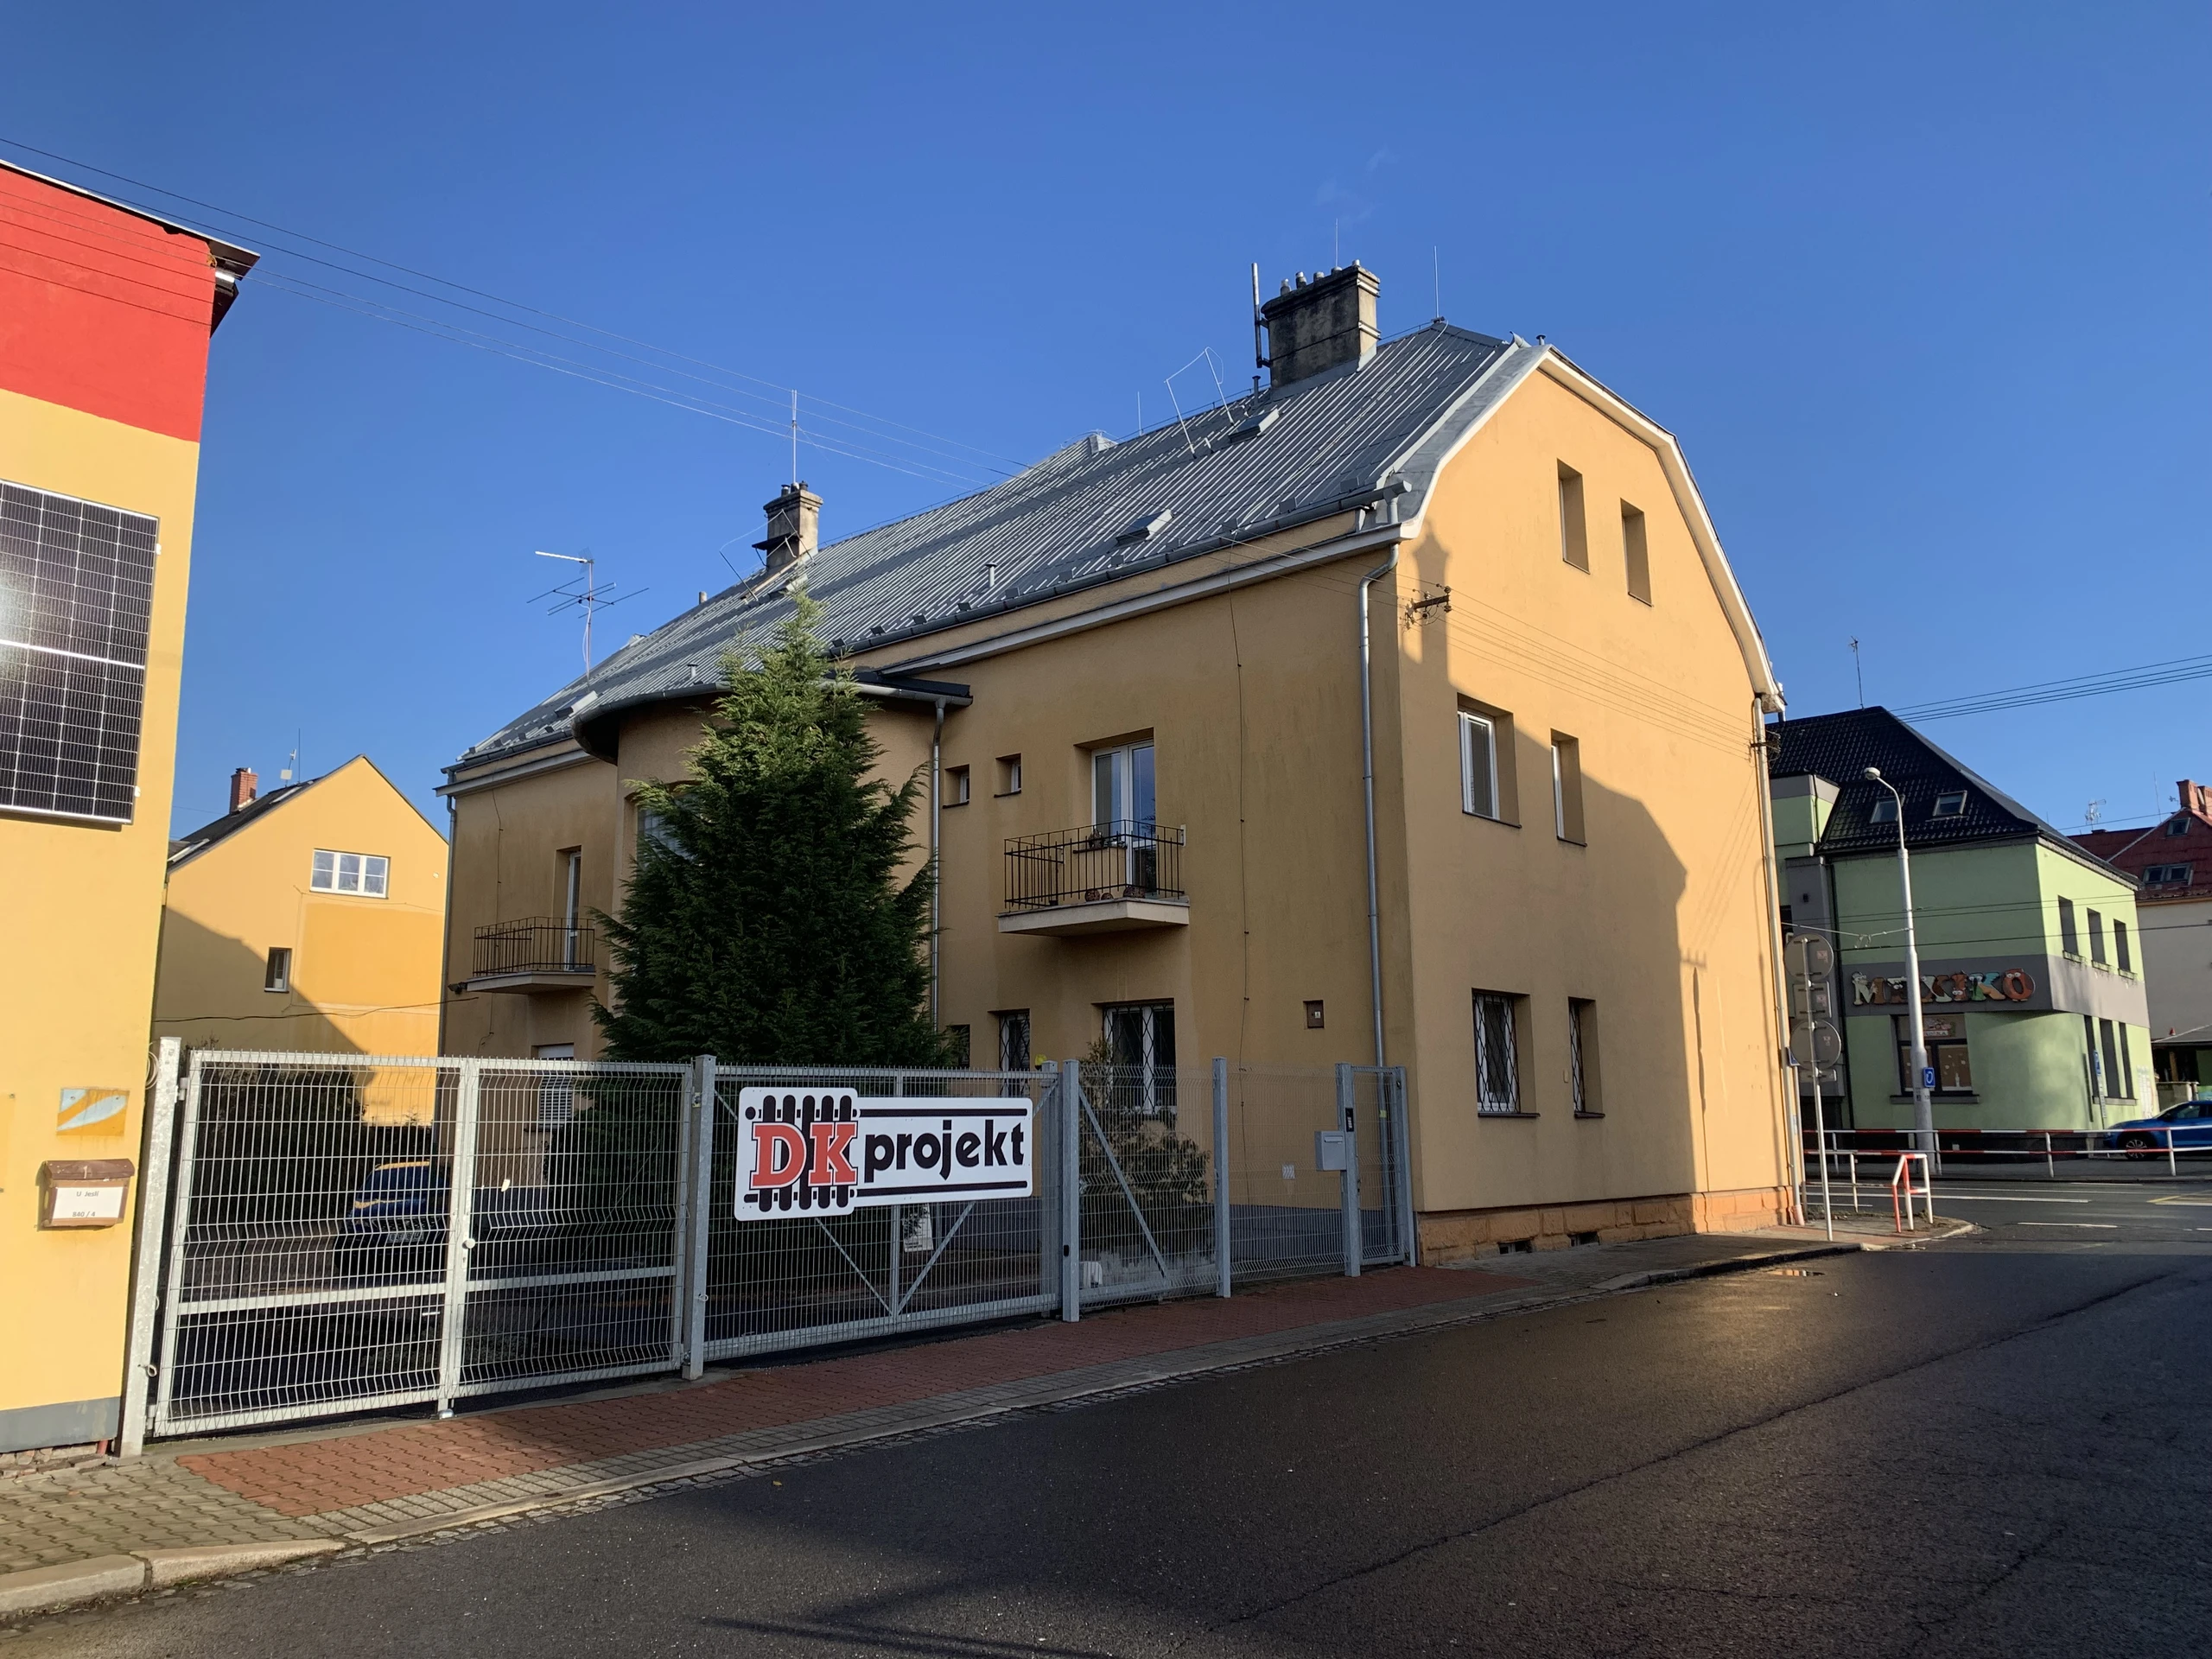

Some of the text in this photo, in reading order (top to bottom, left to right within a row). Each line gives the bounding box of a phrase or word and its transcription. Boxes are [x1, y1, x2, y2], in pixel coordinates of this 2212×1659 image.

[1852, 968, 2036, 1006] MEXIKO
[749, 1119, 1025, 1190] DK projekt
